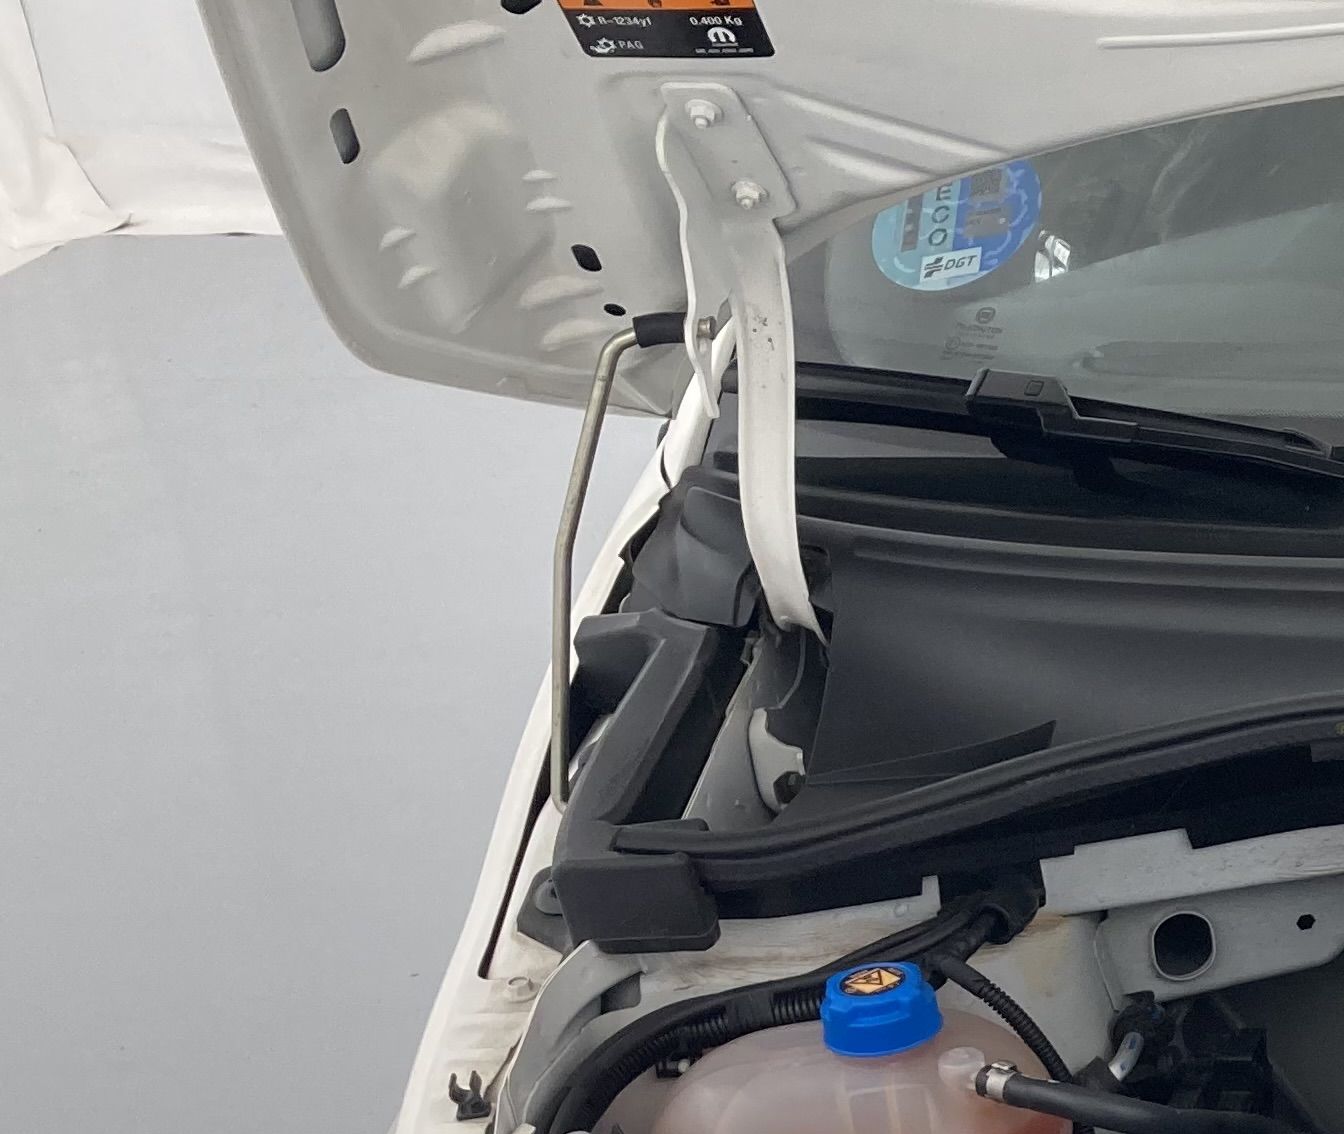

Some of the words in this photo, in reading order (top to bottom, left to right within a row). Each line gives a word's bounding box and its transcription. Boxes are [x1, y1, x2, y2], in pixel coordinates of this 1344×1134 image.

[689, 16, 722, 26] 0.400
[724, 17, 743, 27] Kg
[944, 255, 978, 271] DGT
